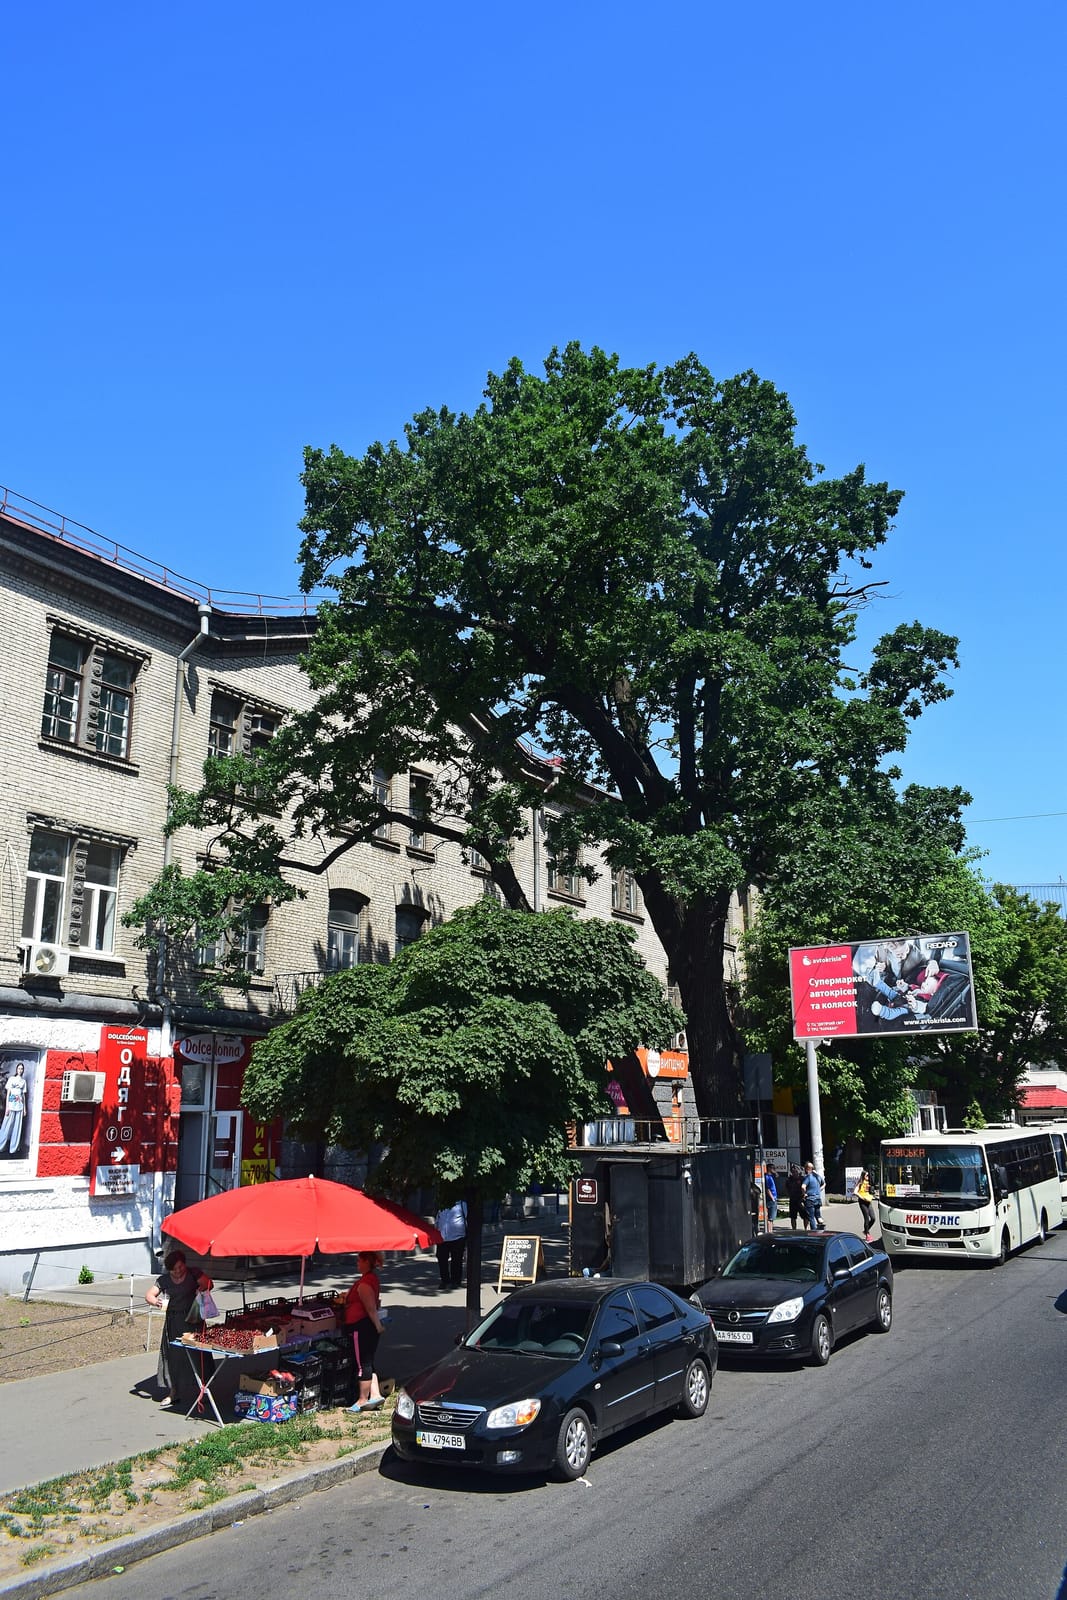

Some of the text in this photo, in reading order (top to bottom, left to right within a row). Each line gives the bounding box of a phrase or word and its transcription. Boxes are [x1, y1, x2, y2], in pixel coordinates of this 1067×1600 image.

[927, 941, 957, 950] RECARO
[808, 976, 868, 987] Супермаркет
[810, 988, 858, 998] автокрісел
[822, 1001, 858, 1009] колясок
[108, 1033, 146, 1042] DOLCEDONNA
[118, 1048, 133, 1122] ОДЯГ
[433, 1435, 451, 1446] 4794
[451, 1437, 463, 1447] BB
